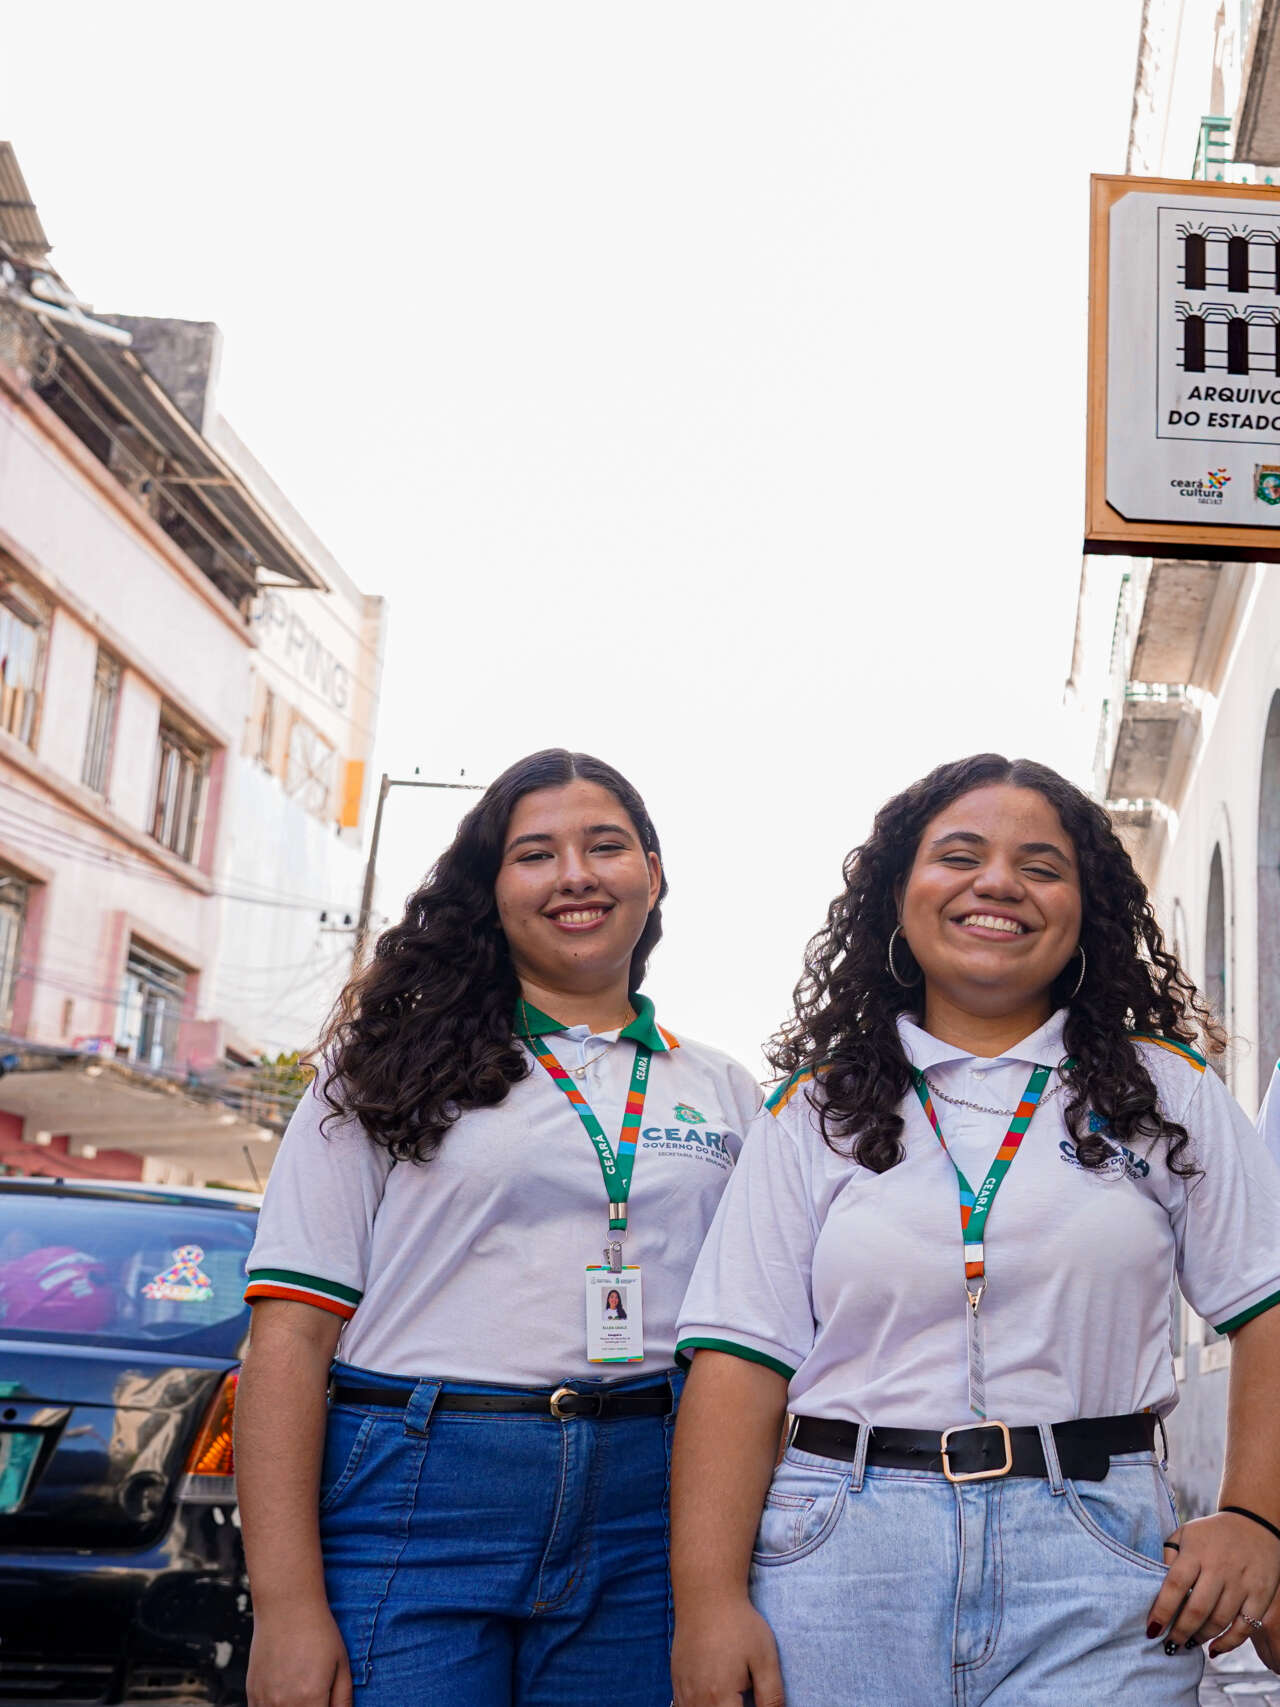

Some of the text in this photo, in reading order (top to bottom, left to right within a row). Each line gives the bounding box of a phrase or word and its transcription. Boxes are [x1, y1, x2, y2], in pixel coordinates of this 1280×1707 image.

[1168, 410, 1200, 426] DO
[1170, 478, 1204, 489] ceará
[1180, 488, 1223, 499] cultura
[636, 1056, 649, 1080] CEARÁ
[592, 1134, 616, 1175] CEARÁ
[642, 1142, 693, 1151] GOVERNO
[695, 1145, 709, 1154] DO
[973, 1177, 996, 1214] CEARÁ
